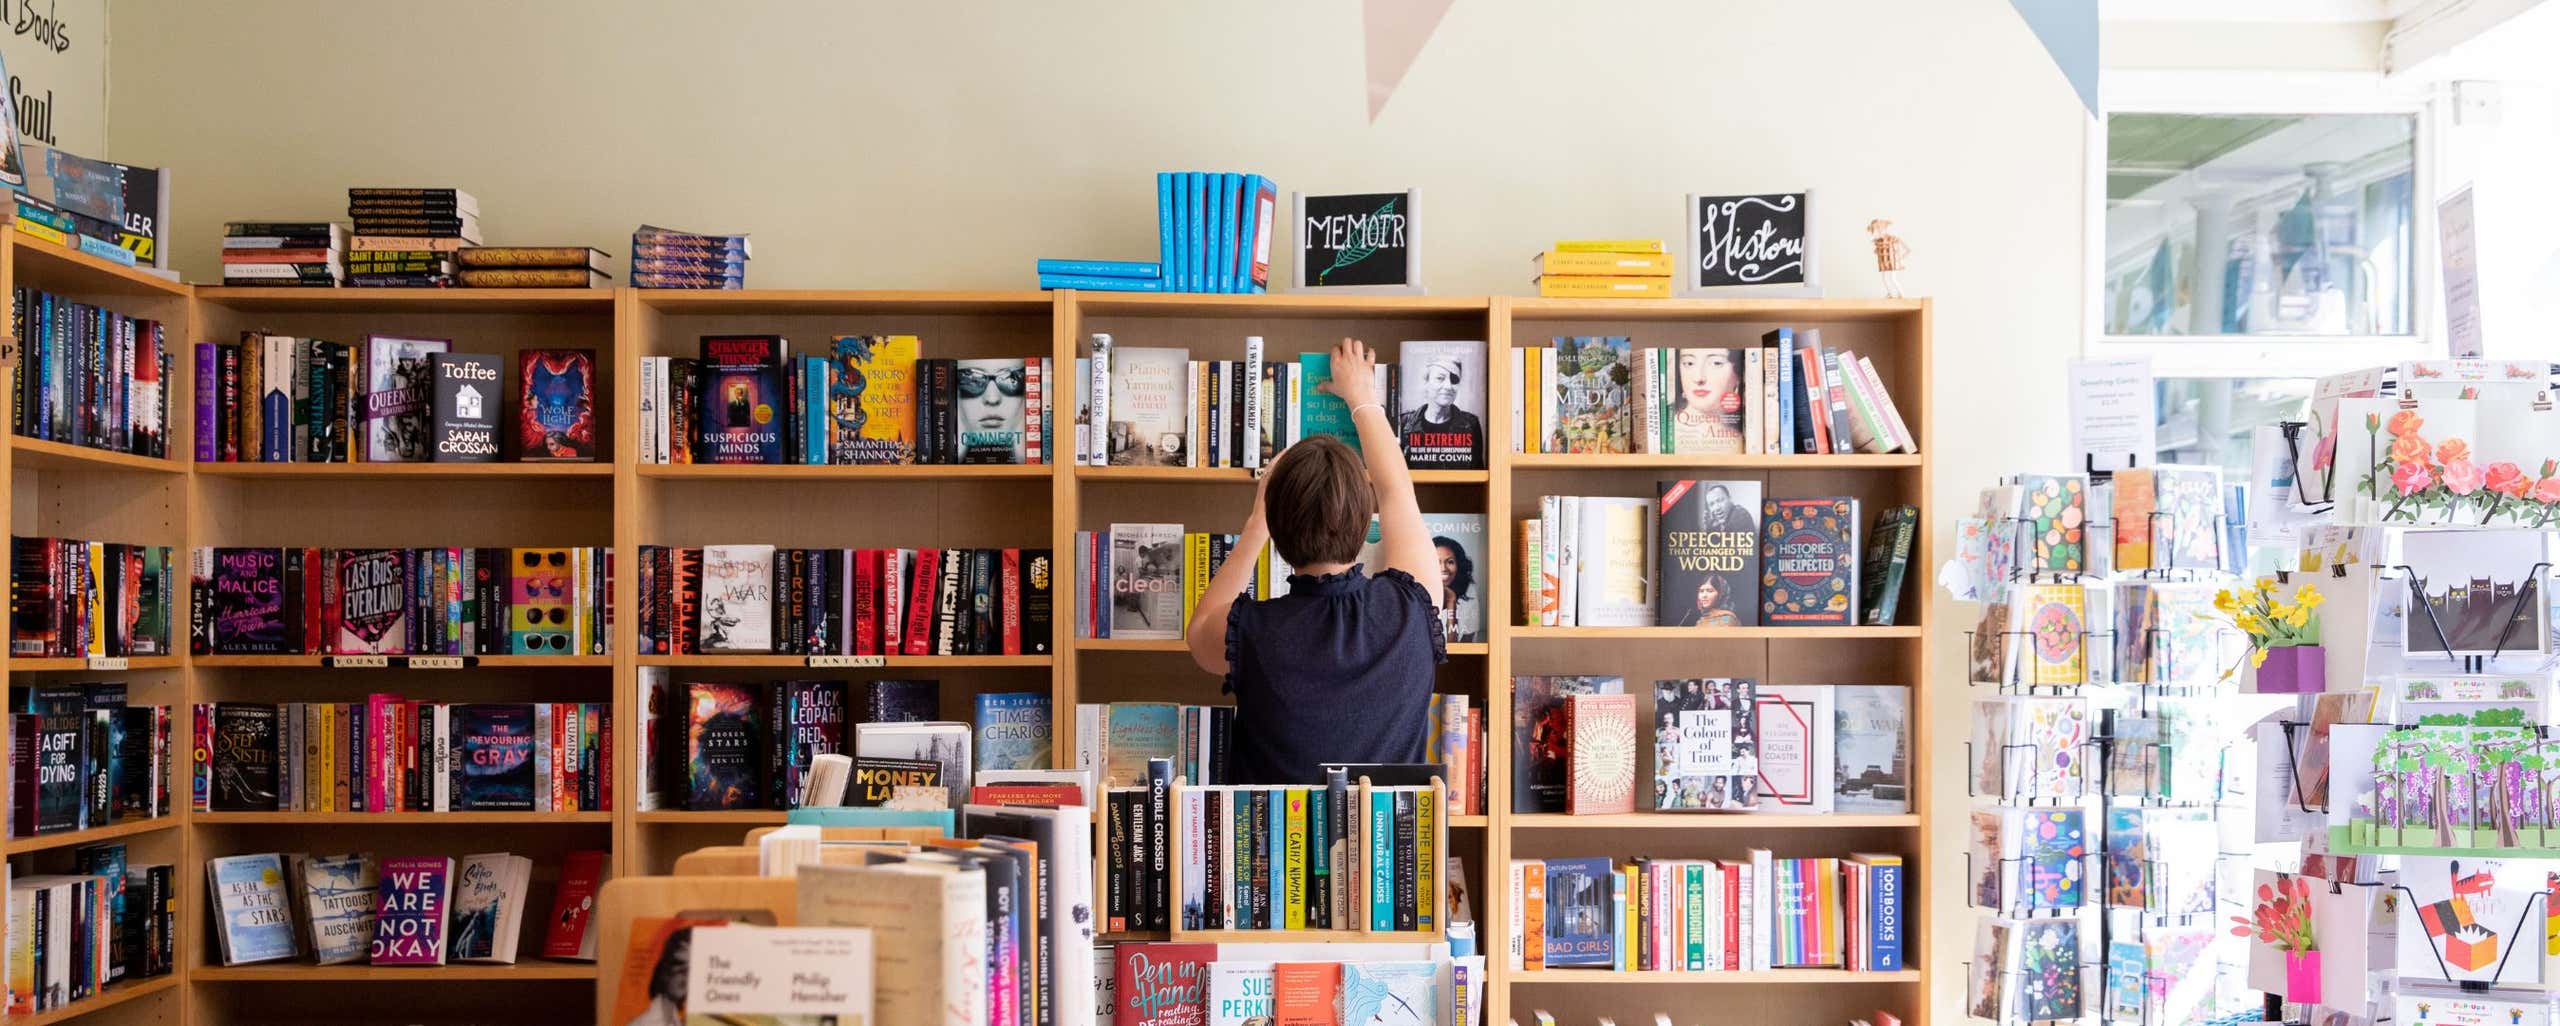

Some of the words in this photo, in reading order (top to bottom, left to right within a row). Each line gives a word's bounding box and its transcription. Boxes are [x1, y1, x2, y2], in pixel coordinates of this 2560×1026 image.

[10, 75, 56, 146] Soul.
[1306, 214, 1405, 250] MEMOIR
[1701, 198, 1805, 281] History
[350, 252, 372, 261] SAINT
[375, 251, 398, 261] DEATH
[351, 264, 371, 274] SAINT
[374, 263, 396, 273] DEATH
[708, 340, 769, 356] STRANGER
[719, 353, 760, 364] THINGS
[1249, 353, 1257, 369] WAS
[442, 362, 496, 380] Toffee
[867, 367, 908, 380] PRIORY
[1094, 357, 1104, 384] LONE
[863, 394, 912, 404] ORANGE
[1028, 366, 1040, 441] LEGENDARY
[1094, 387, 1104, 417] RIDER
[1556, 389, 1629, 405] MEDICI
[541, 405, 575, 415] WOLF
[873, 408, 901, 417] TREE
[1677, 410, 1721, 426] Queen
[543, 414, 572, 425] LIGHT
[448, 430, 489, 442] SARAH
[704, 432, 776, 443] SUSPICIOUS
[961, 432, 1022, 446] CONNECT
[1410, 433, 1420, 446] IN
[1424, 433, 1473, 447] EXTREMIS
[1704, 426, 1739, 438] Anne
[439, 441, 498, 454] CROSSAN
[719, 443, 760, 454] MINDS
[844, 440, 900, 450] SAMANTHA
[844, 451, 900, 460] SHANNON
[1410, 454, 1437, 462] MARIE
[1439, 454, 1472, 462] COLVIN
[1427, 522, 1482, 533] COMING
[1668, 531, 1754, 548] SPEECHES
[1668, 548, 1691, 556] THAT
[1692, 547, 1735, 556] CHANGED
[1737, 548, 1754, 556] THE
[1779, 543, 1833, 555] HISTORIES
[222, 555, 274, 567] MUSIC
[808, 553, 820, 582] Spinning
[1679, 556, 1744, 571] WORLD
[1778, 558, 1834, 572] UNEXPECTED
[240, 570, 258, 578] AND
[345, 561, 370, 591] LAST
[372, 560, 393, 584] BUS
[1034, 556, 1042, 590] WARS
[218, 580, 279, 593] MALICE
[791, 551, 802, 617] CIRCE
[1115, 573, 1177, 593] clean
[725, 585, 768, 601] WAR
[810, 583, 819, 606] Silver
[345, 583, 404, 620] EVERLAND
[222, 643, 247, 651] ALEX
[251, 642, 277, 651] BELL
[335, 658, 385, 666] YOUNG
[411, 658, 460, 666] ADULT
[812, 657, 880, 665] FANTASY
[802, 691, 840, 707] BLACK
[791, 706, 844, 724] LEOPARD
[994, 709, 1042, 723] TIME'S
[1696, 714, 1719, 726] The
[470, 736, 531, 744] DEVOURING
[799, 726, 821, 743] RED
[985, 726, 1052, 740] CHARIOT
[1684, 727, 1728, 738] Colour
[42, 735, 52, 751] A
[53, 733, 77, 751] GIFT
[567, 711, 577, 771] ILLUMINAE
[1700, 739, 1712, 752] of
[1767, 744, 1793, 752] ROLLER
[51, 753, 66, 765] FOR
[194, 718, 207, 792] PROUD
[473, 749, 529, 765] GRAY
[1691, 752, 1723, 764] Time
[1764, 753, 1798, 761] COASTER
[40, 764, 76, 784] DYING
[856, 769, 936, 786] MONEY
[1154, 778, 1164, 821] DOUBLE
[1419, 796, 1431, 818] ON
[1111, 802, 1124, 842] DAMAGED
[1133, 804, 1143, 842] GENTLEMAN
[1375, 811, 1384, 868] UNNATURAL
[1419, 824, 1430, 847] THE
[1133, 844, 1143, 863] JACK
[1154, 823, 1164, 871] CROSSED
[1290, 832, 1302, 862] CATHY
[1039, 859, 1047, 876] IAN
[1419, 853, 1430, 881] LINE
[232, 883, 242, 894] AS
[392, 872, 432, 890] WE
[1376, 870, 1385, 904] CAUSES
[243, 896, 254, 906] AS
[257, 894, 273, 905] THE
[323, 892, 373, 911] TATTOOIST
[383, 893, 435, 911] ARE
[999, 887, 1009, 912] BOY
[1039, 878, 1047, 919] McEWAN
[251, 908, 286, 925] STARS
[324, 920, 374, 937] AUSCHWIT
[380, 919, 436, 937] NOT
[371, 939, 442, 958] OKAY
[999, 916, 1010, 985] SWALLOWS
[1546, 942, 1573, 953] BAD
[1576, 941, 1609, 952] GIRLS
[709, 956, 731, 969] The
[1040, 936, 1048, 985] MACHINES
[1129, 952, 1174, 990] Pen
[1179, 960, 1195, 977] in
[706, 972, 762, 989] Friendly
[792, 972, 831, 988] Philip
[1242, 978, 1273, 996] SUE
[705, 990, 741, 1003] Ones
[791, 991, 848, 1003] Hensher
[1040, 987, 1048, 1006] LIKE
[1131, 965, 1207, 1018] Hand
[1456, 985, 1467, 1006] BILLY
[1040, 1009, 1048, 1023] ME
